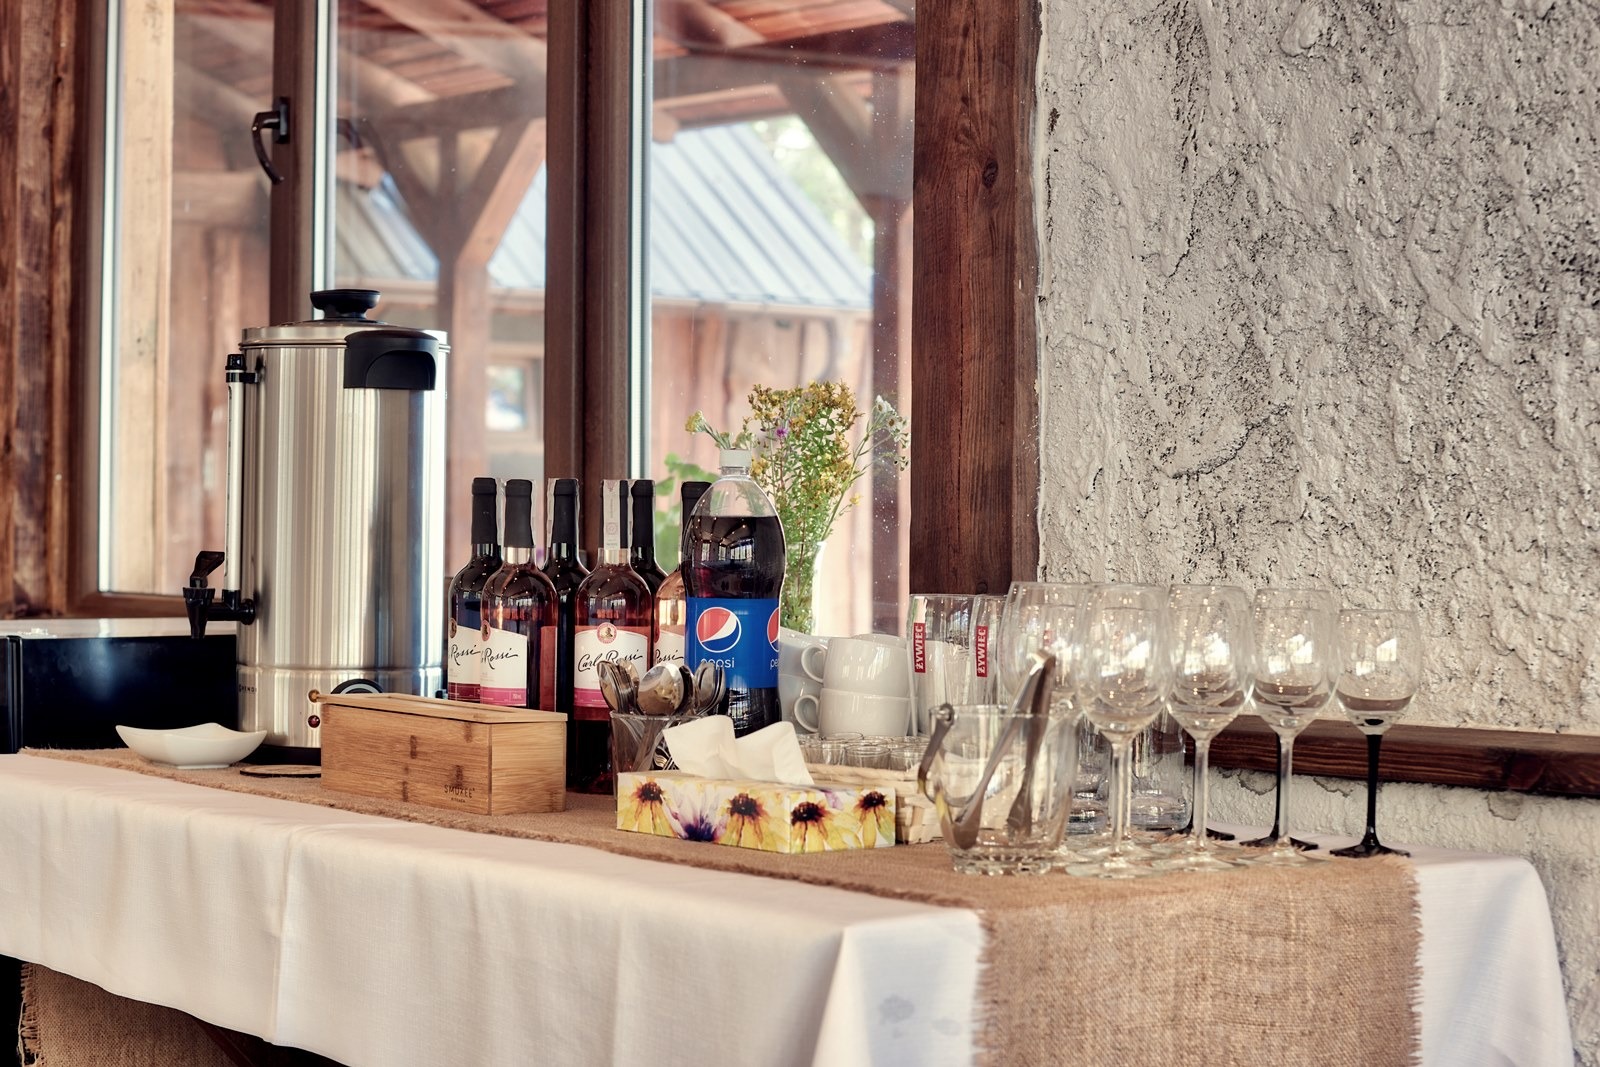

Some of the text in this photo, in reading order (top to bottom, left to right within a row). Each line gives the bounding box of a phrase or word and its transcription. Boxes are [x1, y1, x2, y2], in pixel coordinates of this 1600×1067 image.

[451, 643, 480, 666] Rossi
[484, 647, 519, 670] Rossi
[577, 653, 603, 672] Carl
